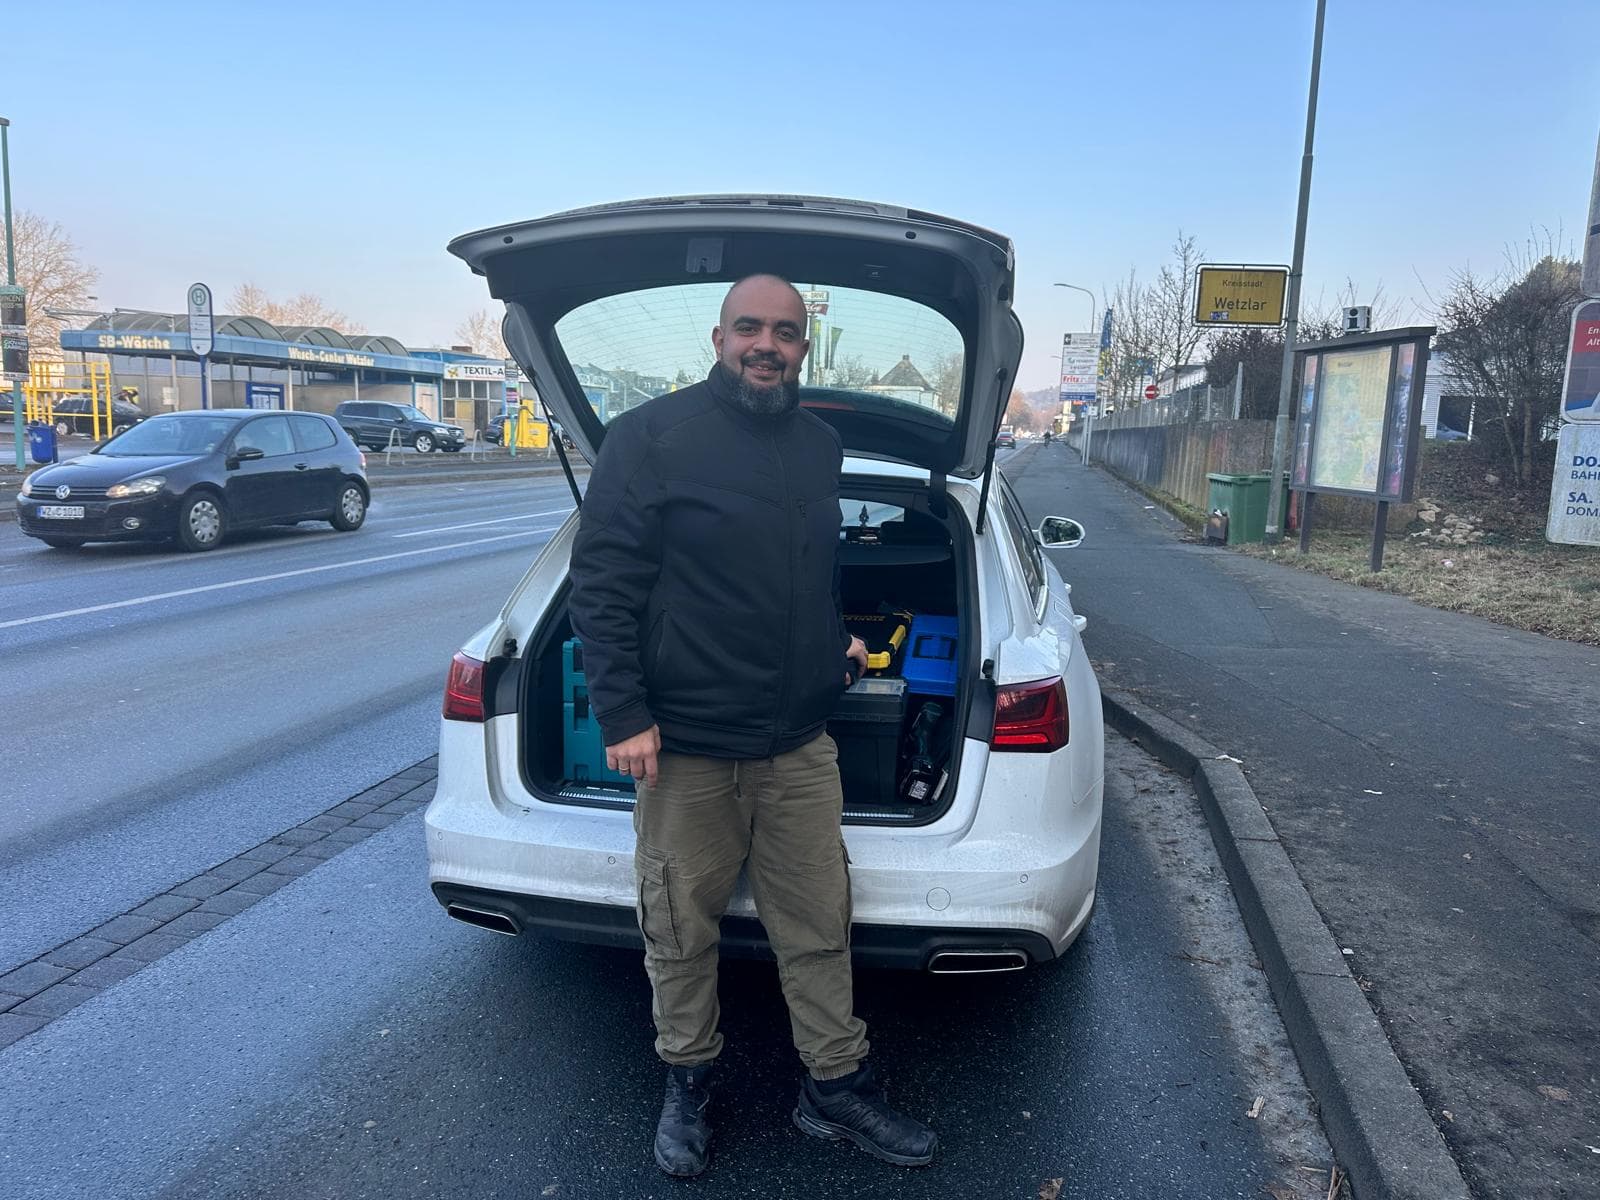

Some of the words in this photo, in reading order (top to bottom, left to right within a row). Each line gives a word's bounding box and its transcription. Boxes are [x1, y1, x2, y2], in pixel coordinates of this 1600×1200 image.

[1222, 279, 1264, 288] Kreisstadt
[1214, 296, 1268, 311] Wetzlar
[98, 334, 171, 350] SB-Wäsche
[1063, 375, 1080, 383] Fritz
[1571, 470, 1600, 481] BAH
[1567, 491, 1593, 504] SA.
[1566, 506, 1600, 517] DOM
